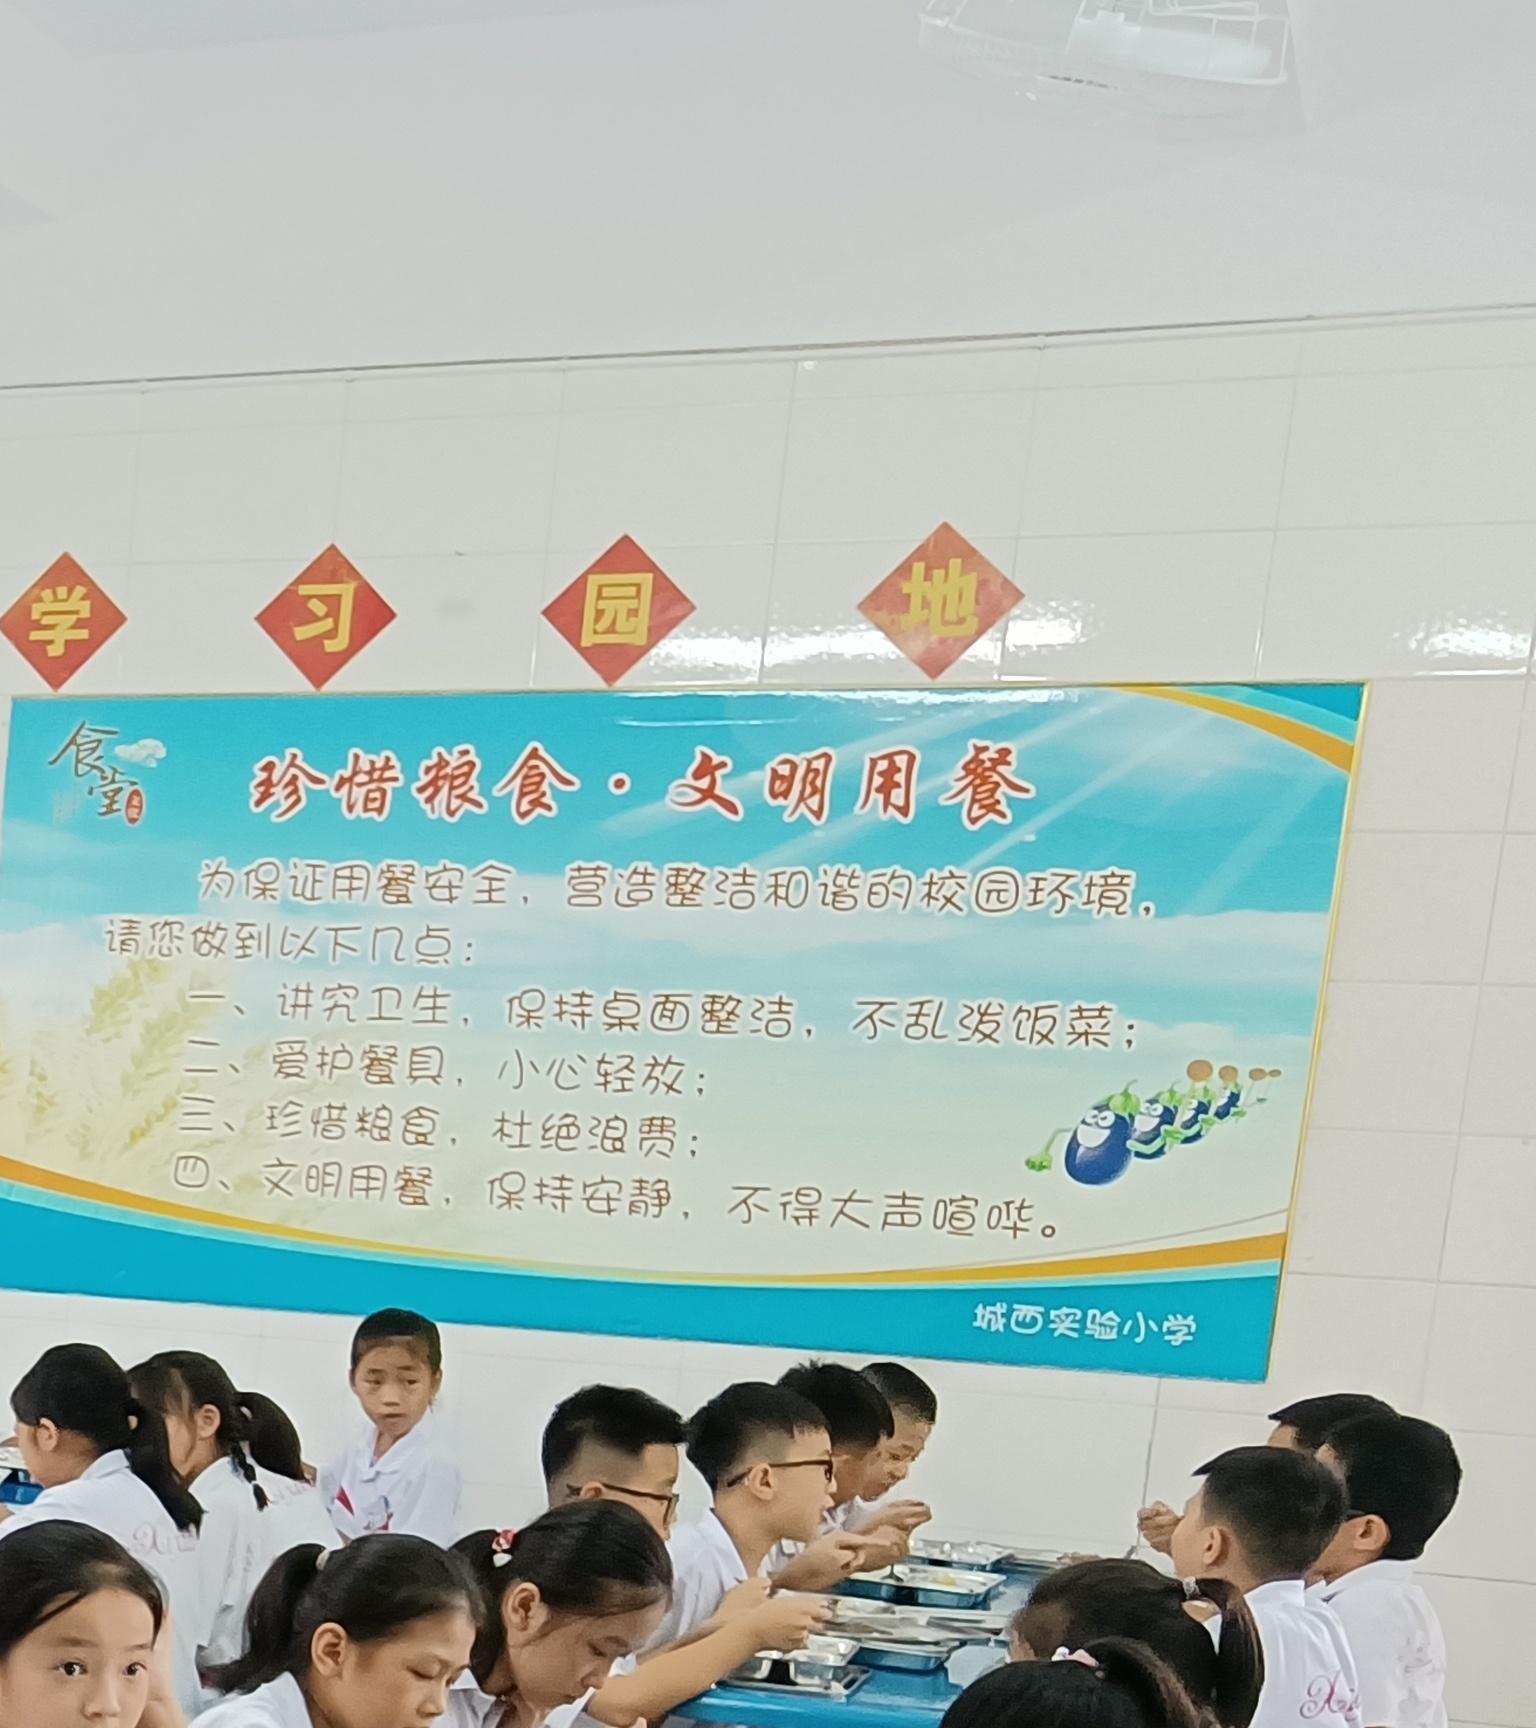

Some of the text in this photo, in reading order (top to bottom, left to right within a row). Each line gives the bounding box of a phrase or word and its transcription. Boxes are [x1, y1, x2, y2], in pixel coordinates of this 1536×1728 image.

[973, 1302, 1197, 1345] 城西实验小学
